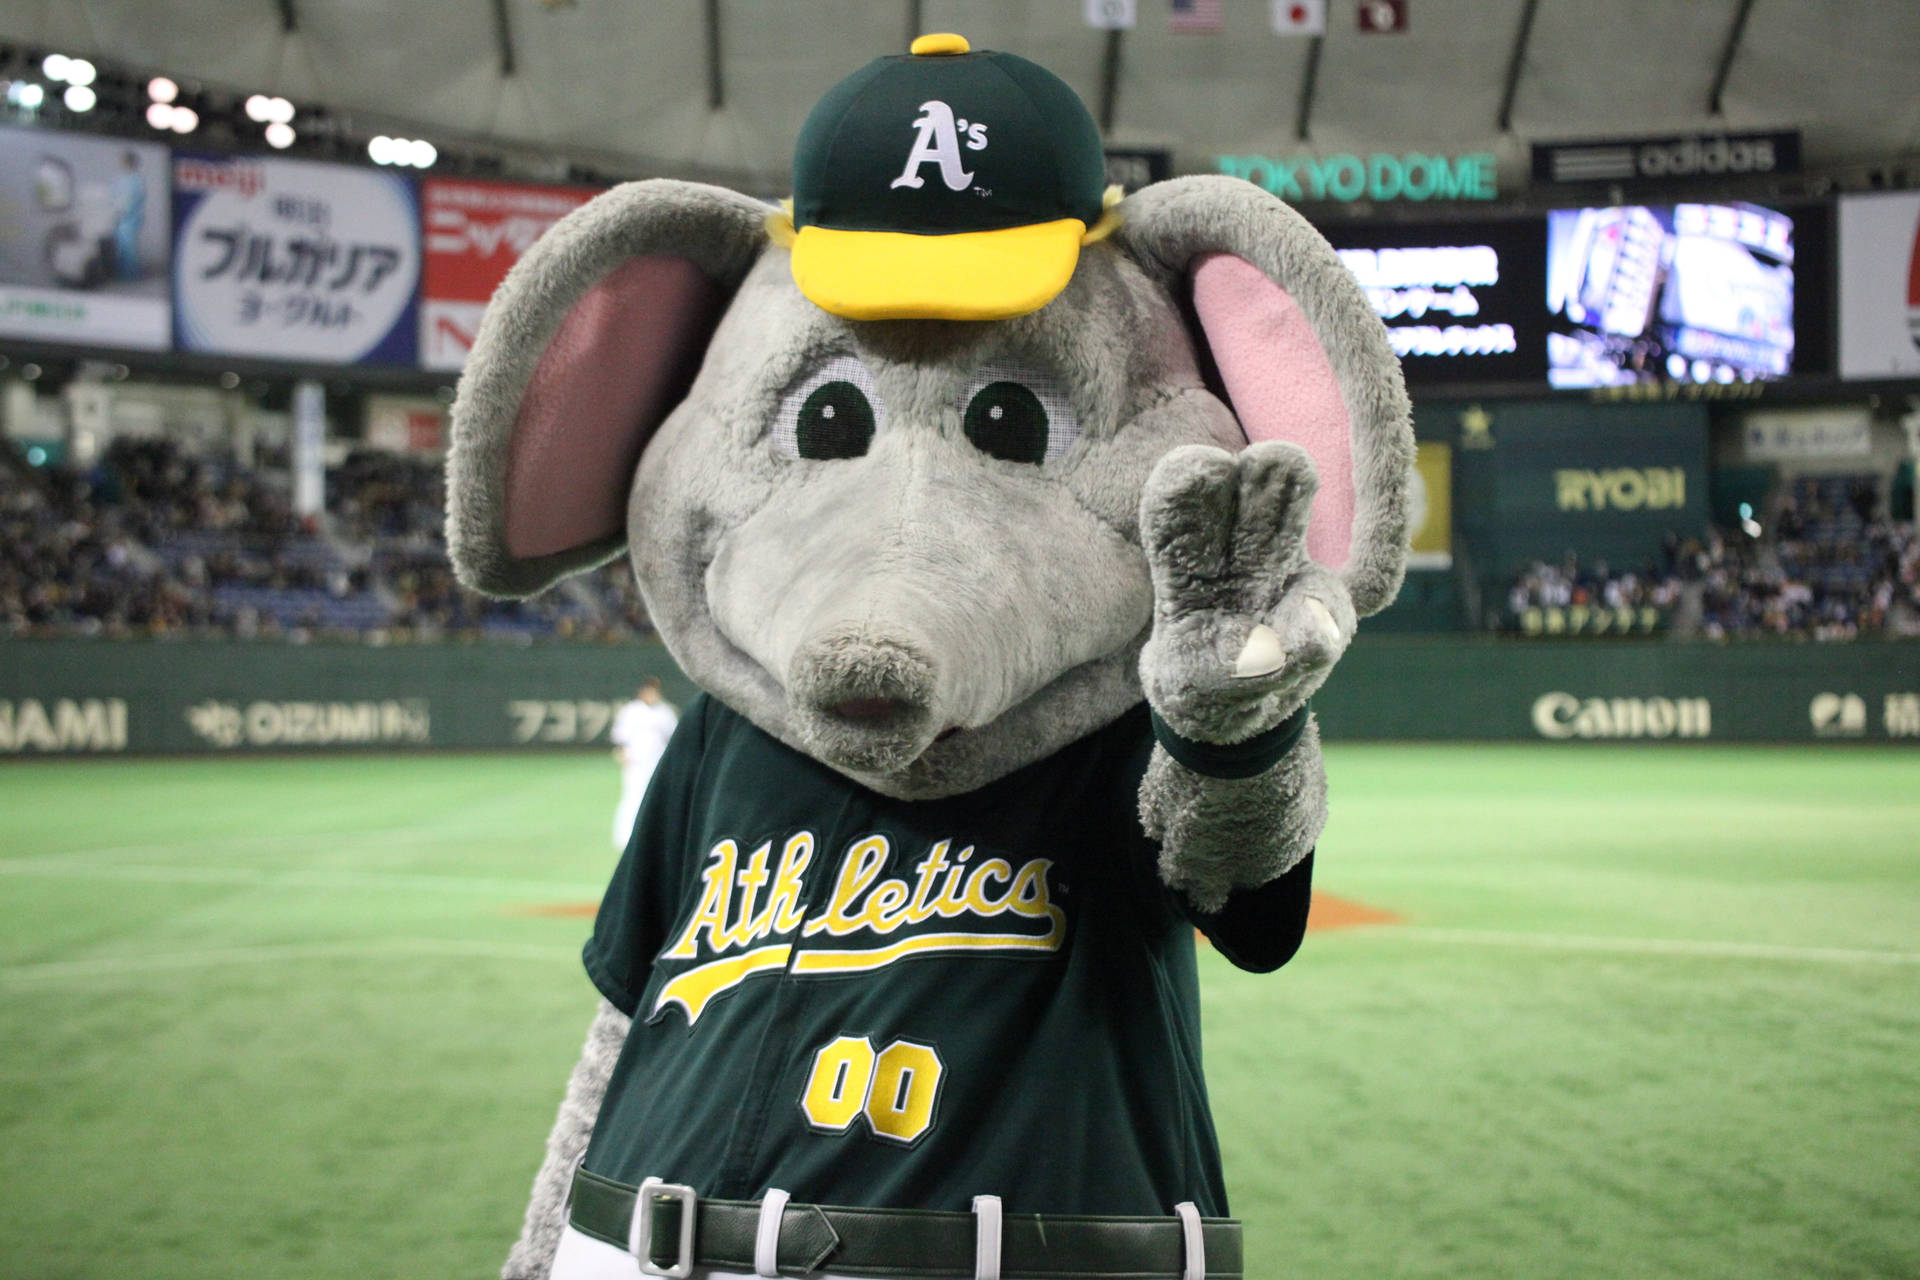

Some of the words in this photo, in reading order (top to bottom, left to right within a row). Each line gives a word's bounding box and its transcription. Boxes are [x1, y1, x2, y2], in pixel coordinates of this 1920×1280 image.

[891, 100, 988, 191] A's
[1638, 138, 1776, 176] adidas
[1368, 153, 1498, 201] DOME
[200, 221, 402, 294] ブルガリア
[1556, 467, 1686, 511] RYOBI
[1532, 691, 1712, 739] Canon
[660, 830, 1064, 962] Athletics
[801, 1035, 943, 1143] 00
